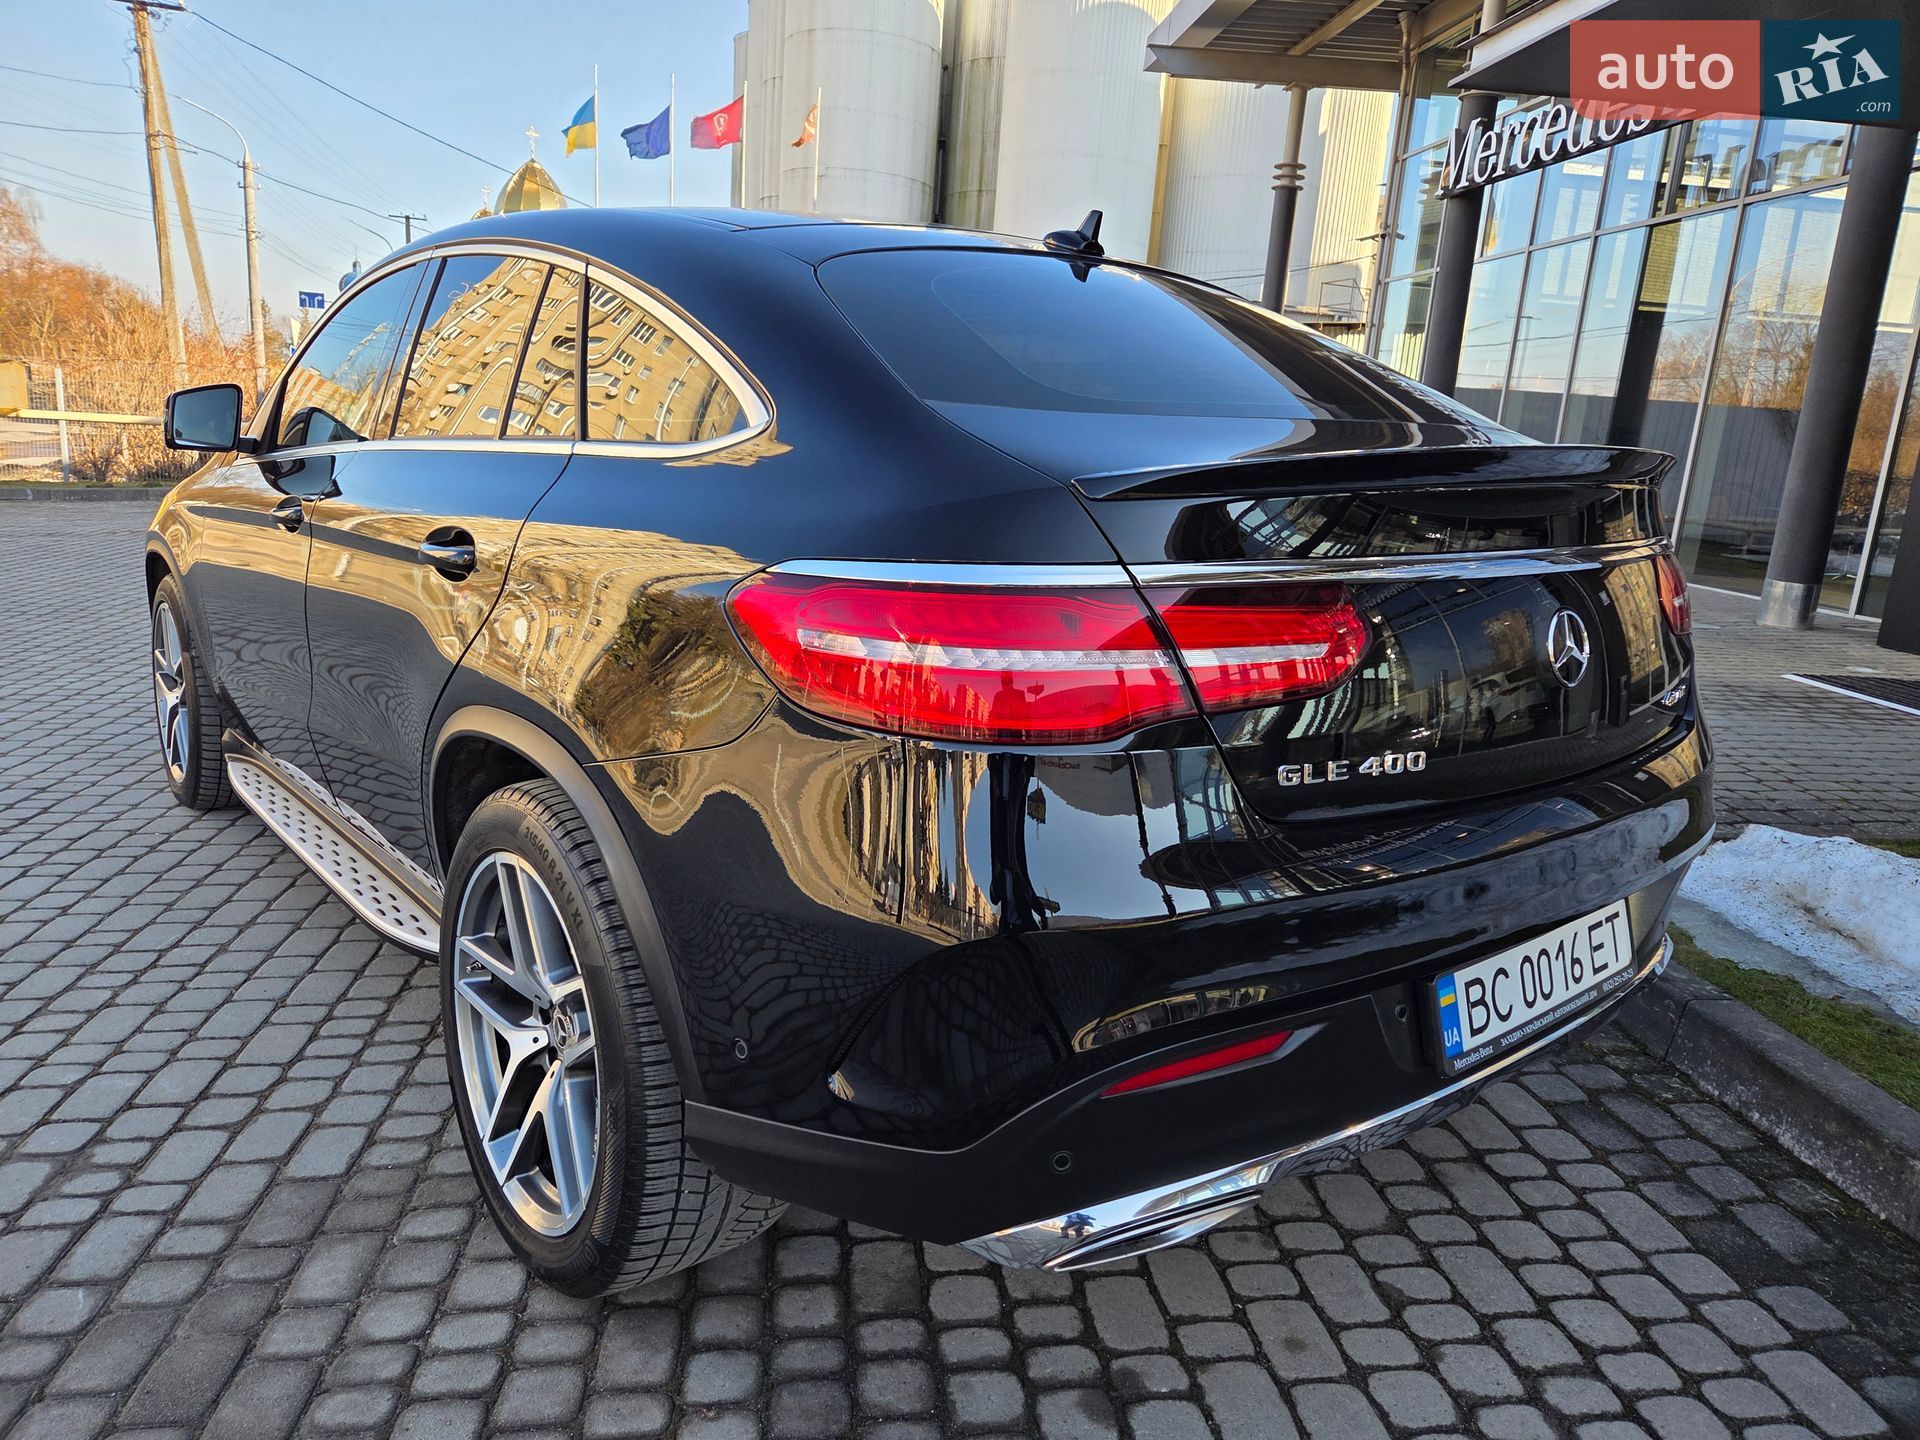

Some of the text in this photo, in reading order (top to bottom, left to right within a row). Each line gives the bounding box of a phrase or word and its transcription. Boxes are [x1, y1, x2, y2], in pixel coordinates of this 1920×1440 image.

[1277, 750, 1427, 787] GLE 400
[523, 826, 549, 861] 315/40
[548, 858, 557, 874] R
[1464, 911, 1621, 1038] BC 0016 ET
[1444, 1030, 1461, 1047] UA
[1453, 1045, 1494, 1071] Mercedes-Benz
